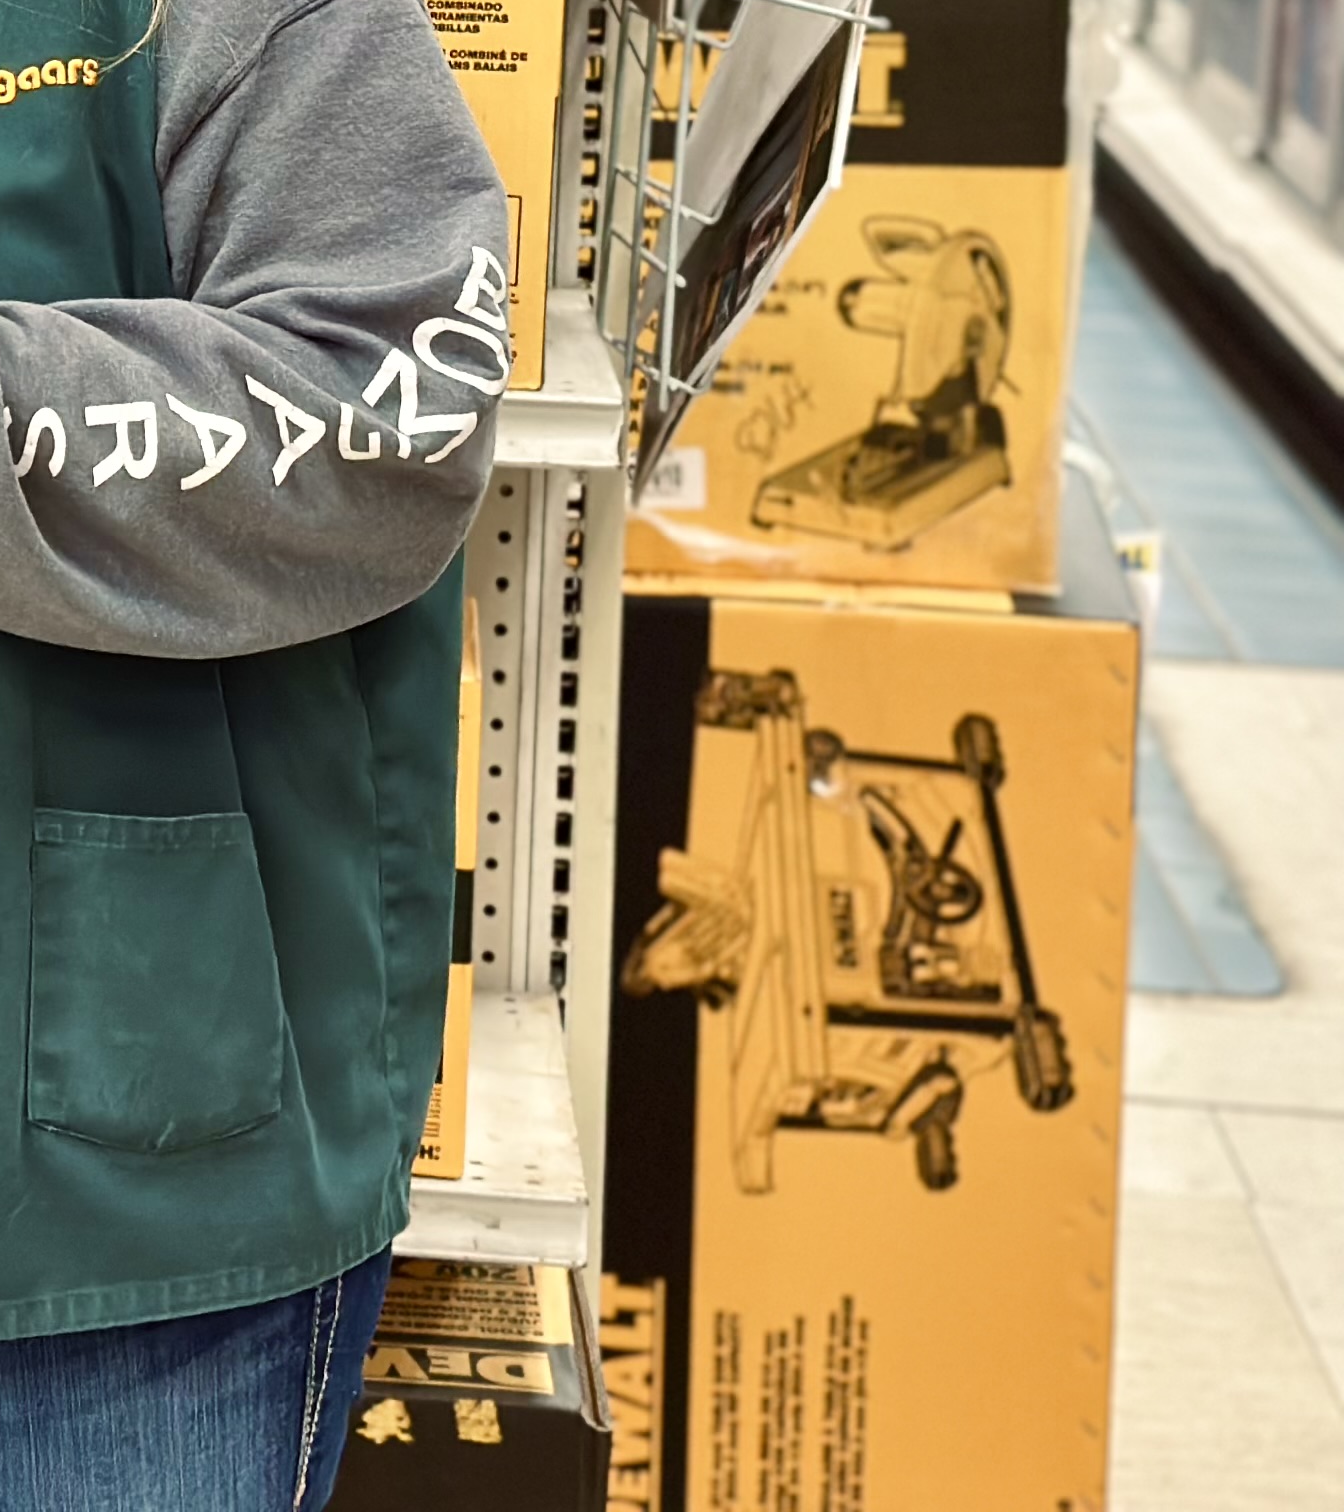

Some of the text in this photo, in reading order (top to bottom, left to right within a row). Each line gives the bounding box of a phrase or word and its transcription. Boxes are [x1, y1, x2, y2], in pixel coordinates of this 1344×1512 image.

[427, 0, 502, 12] COMBINADO
[430, 12, 509, 23] RRAMIENTAS
[449, 49, 527, 61] COMBINÉ DE
[473, 62, 517, 72] BALAIS
